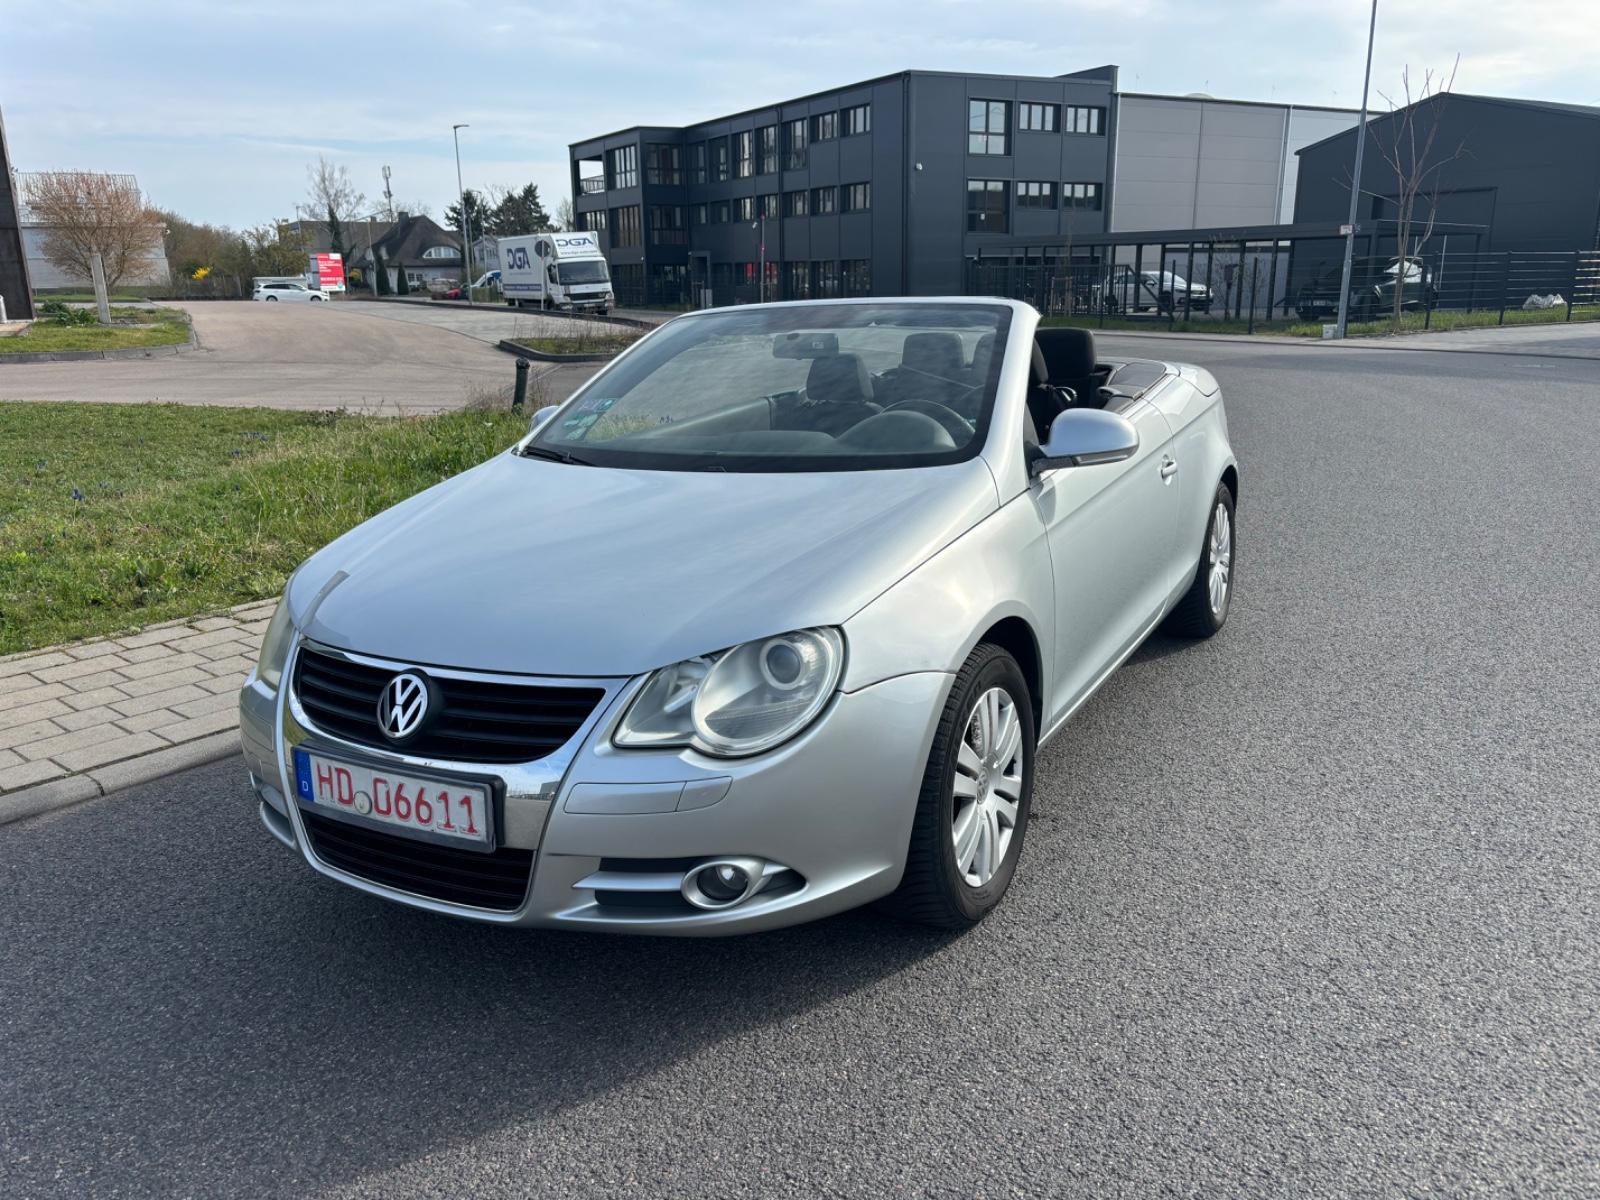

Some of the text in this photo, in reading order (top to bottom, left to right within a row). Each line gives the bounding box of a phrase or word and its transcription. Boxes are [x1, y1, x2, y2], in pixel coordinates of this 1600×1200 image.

[555, 237, 594, 247] DGA
[507, 247, 531, 270] DGA
[377, 673, 428, 738] VW
[301, 780, 309, 792] D
[316, 762, 480, 835] HD 06611
